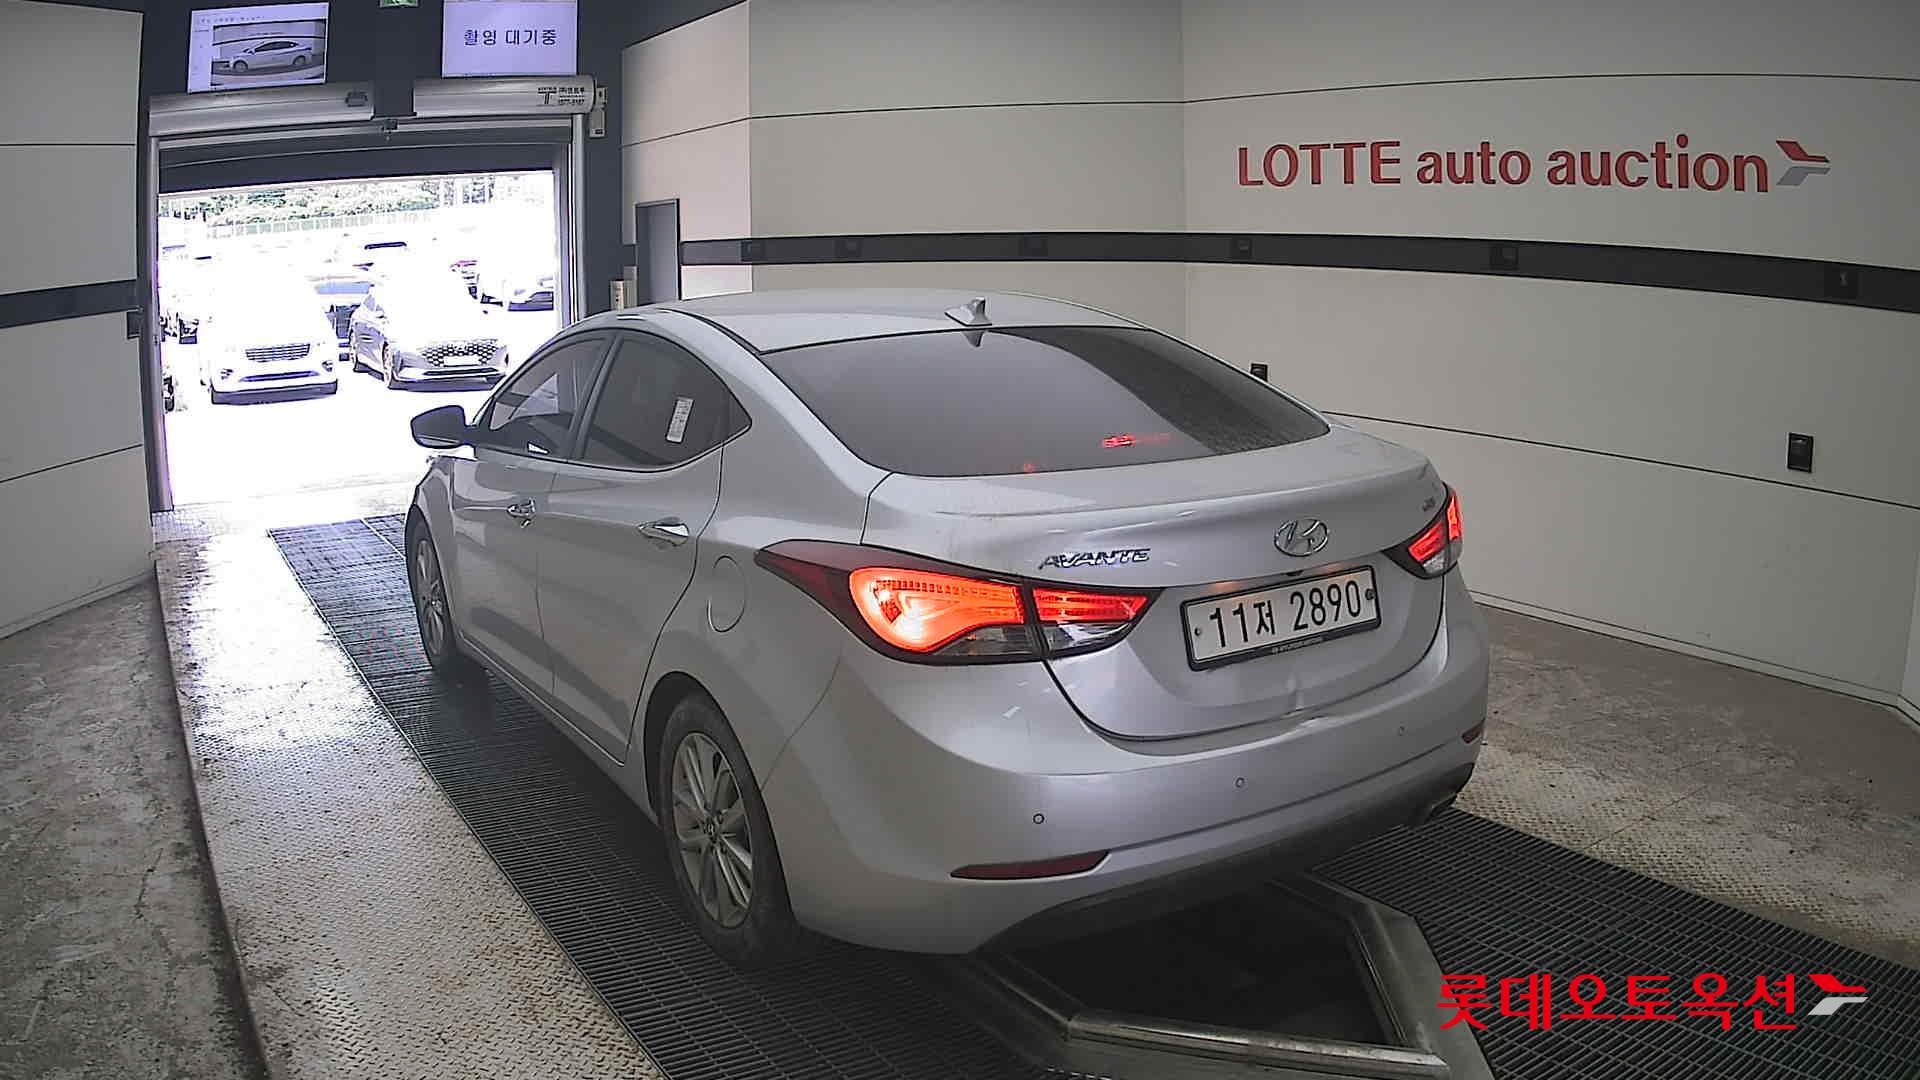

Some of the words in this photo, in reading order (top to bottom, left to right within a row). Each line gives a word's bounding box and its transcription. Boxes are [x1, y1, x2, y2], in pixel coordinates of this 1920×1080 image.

[505, 29, 557, 46] 대기중
[1238, 140, 1401, 187] LOTTE
[1416, 141, 1531, 185] auto
[1547, 134, 1769, 193] auction
[1038, 548, 1151, 570] AVANTE
[1209, 600, 1276, 648] 11저
[1289, 580, 1361, 631] 2890
